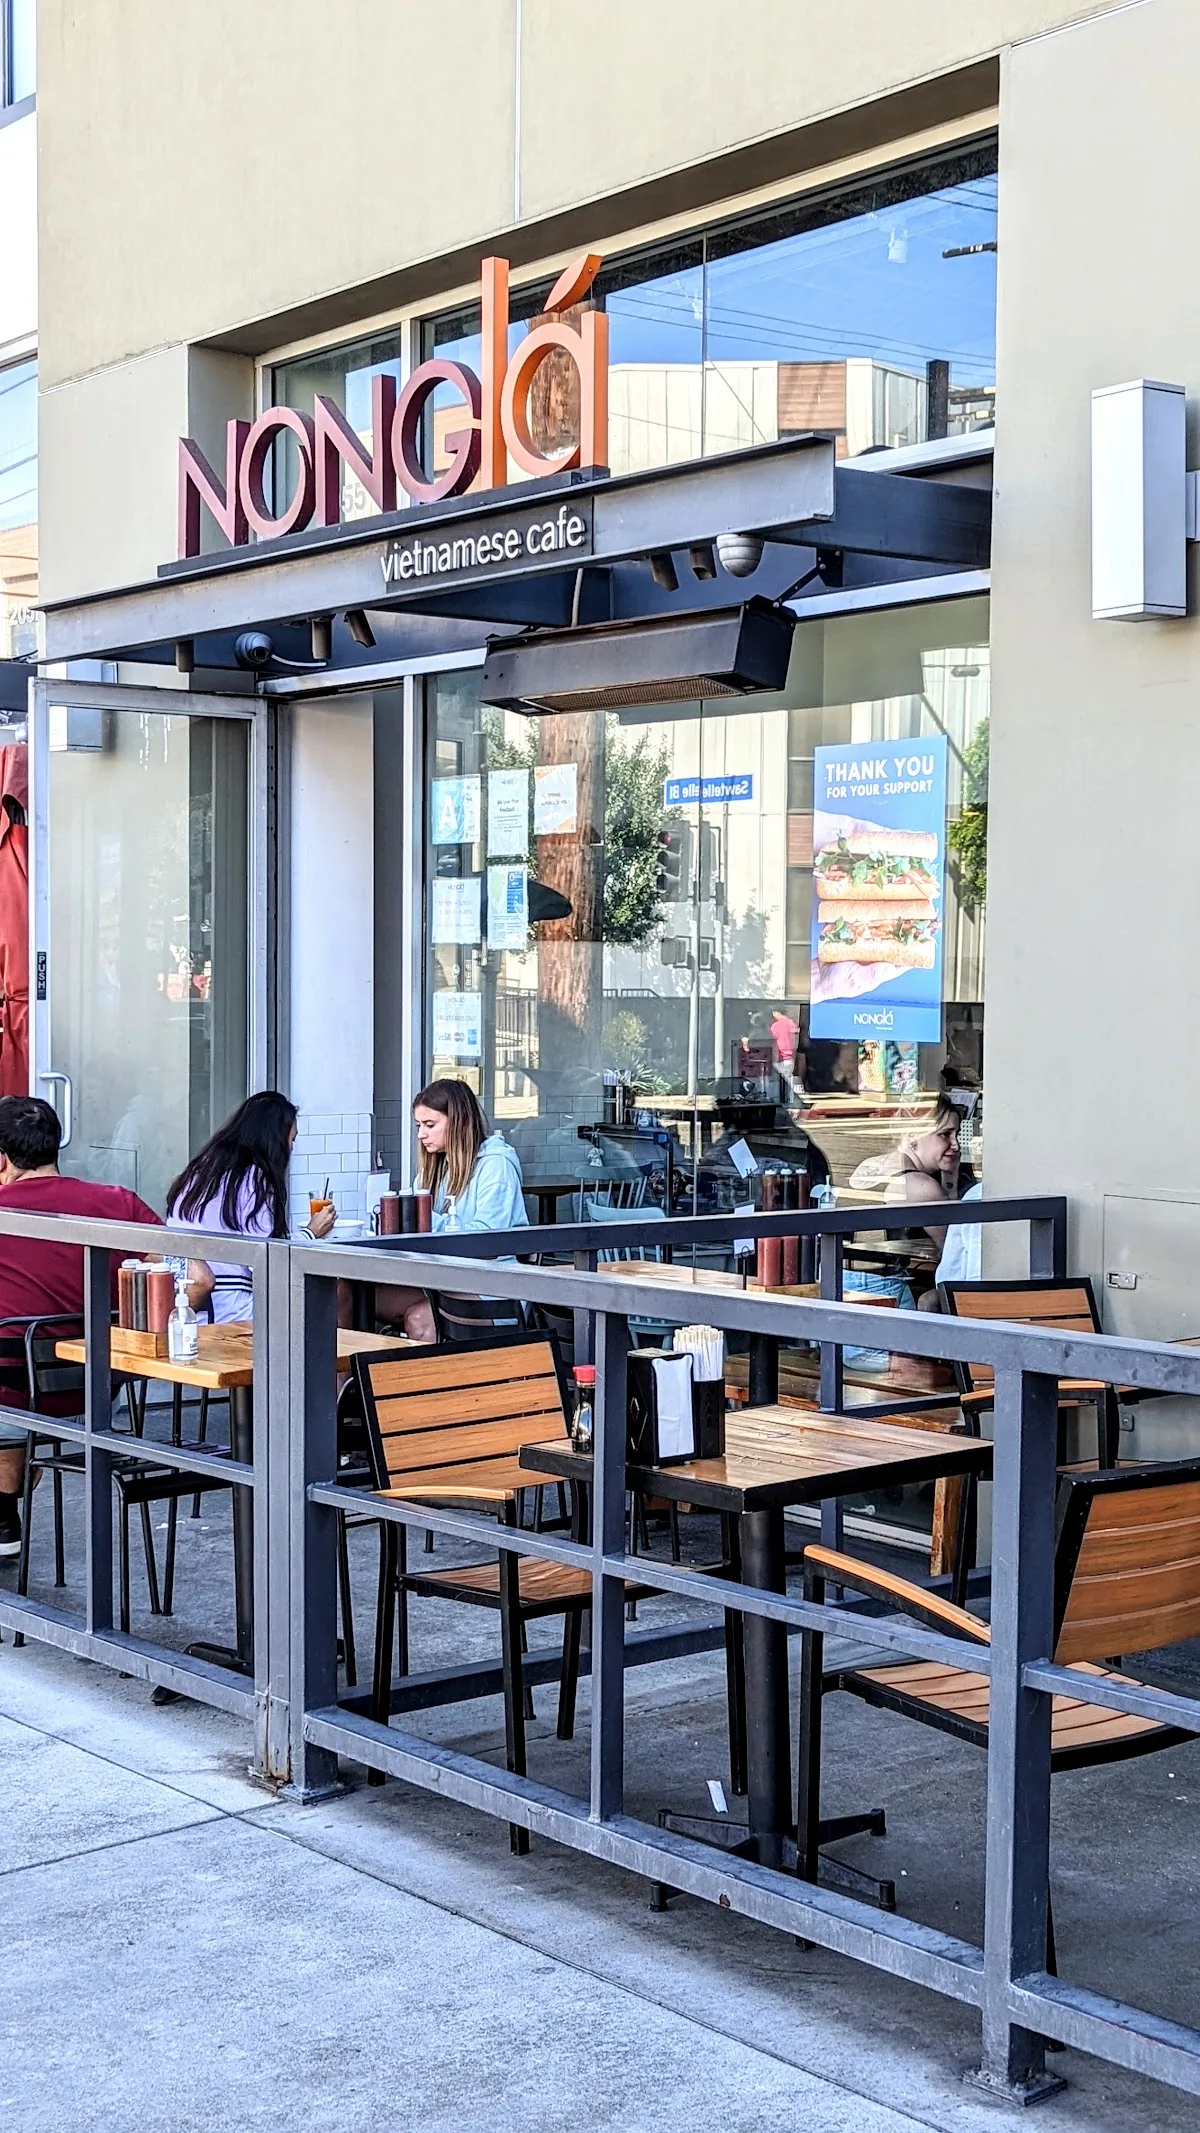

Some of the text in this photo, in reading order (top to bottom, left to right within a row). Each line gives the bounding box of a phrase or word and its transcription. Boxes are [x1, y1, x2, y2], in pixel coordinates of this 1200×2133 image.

[380, 505, 586, 583] vietnamese cafe
[825, 755, 934, 783] THANK YOU
[826, 780, 934, 799] FOR YOUR SUPPORT
[38, 956, 46, 989] PUSH
